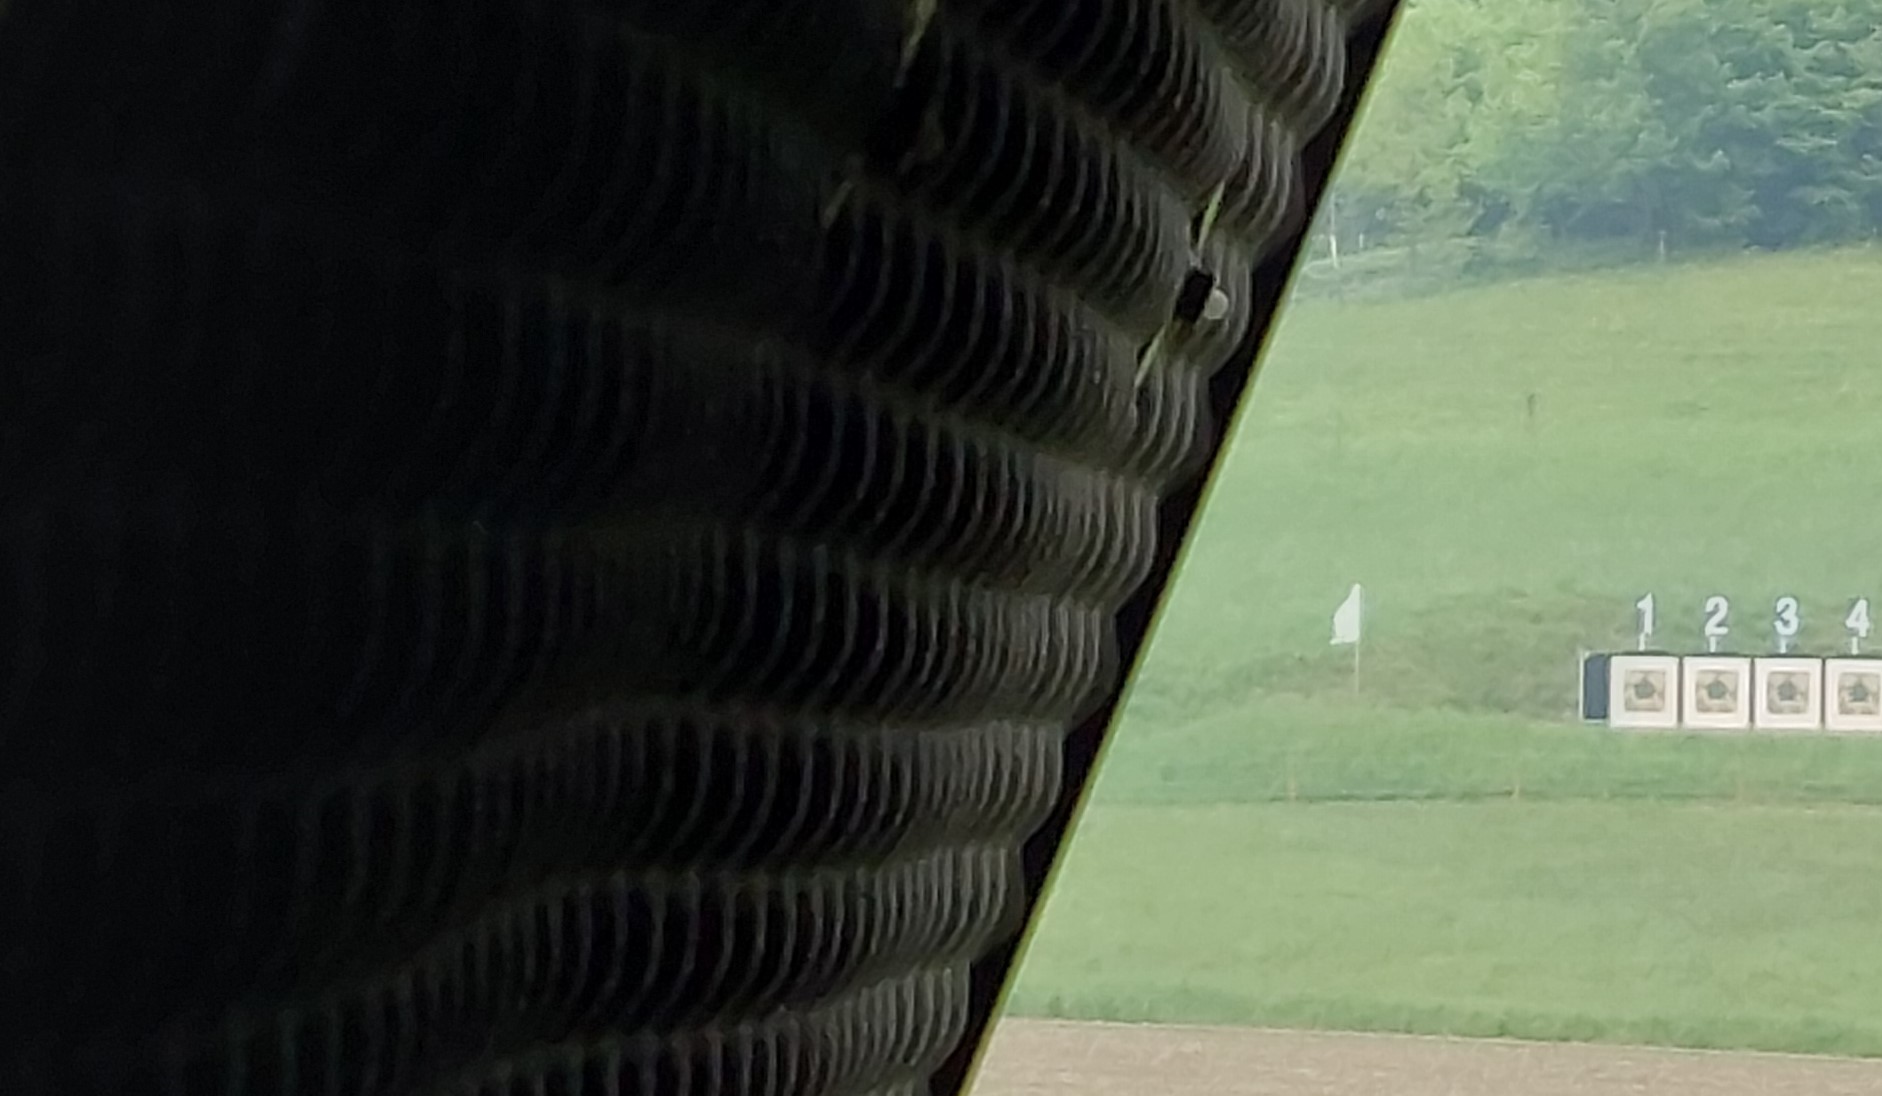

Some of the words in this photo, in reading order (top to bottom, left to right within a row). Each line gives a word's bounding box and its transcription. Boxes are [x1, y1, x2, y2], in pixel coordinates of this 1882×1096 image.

[1637, 594, 1653, 634] 1
[1705, 596, 1728, 636] 2
[1774, 597, 1798, 635] 3
[1845, 599, 1870, 637] 4
